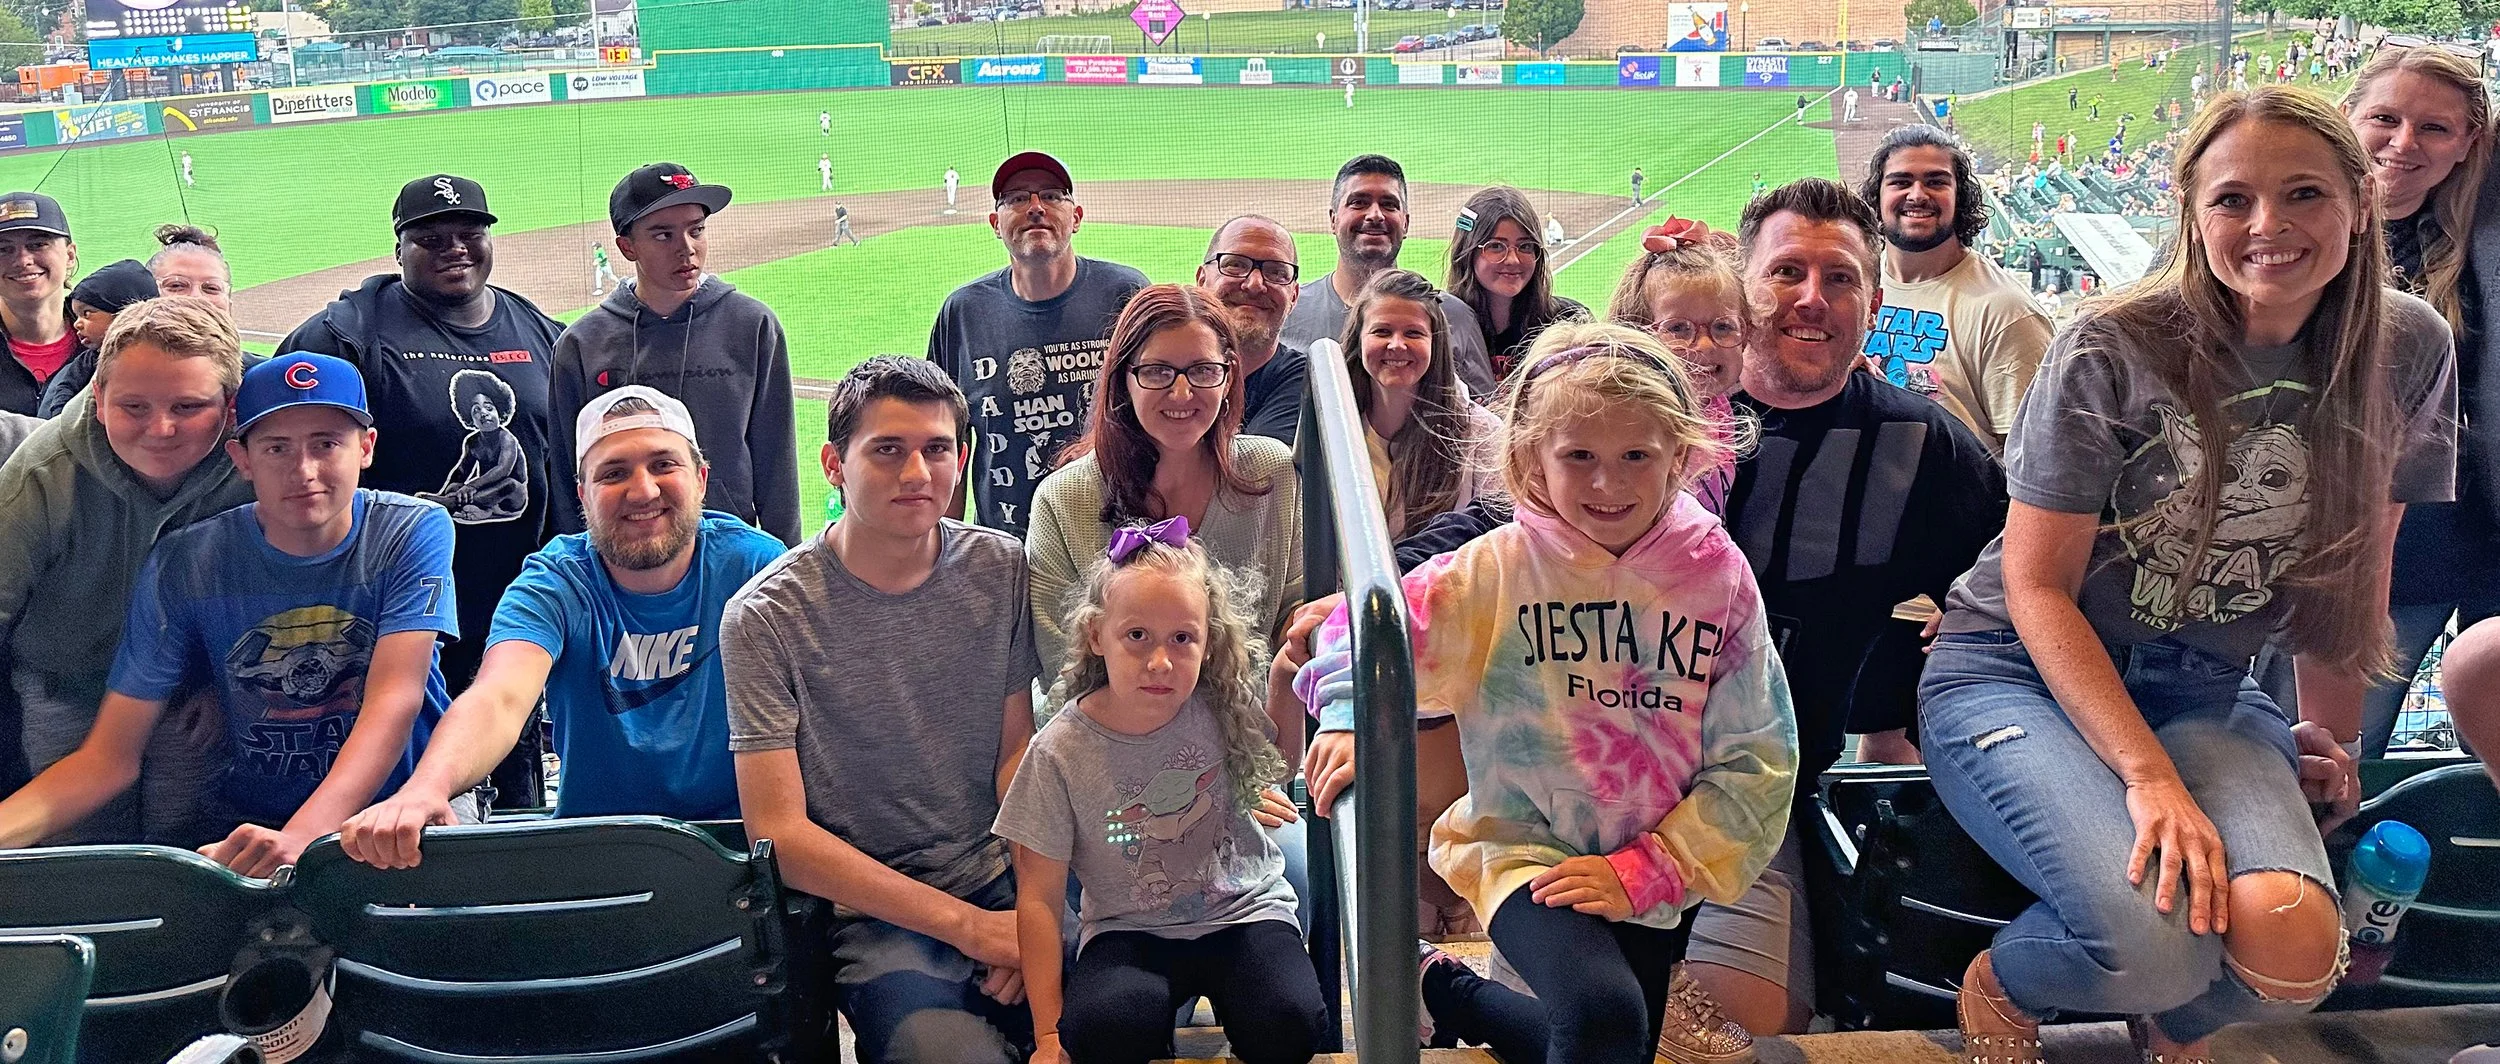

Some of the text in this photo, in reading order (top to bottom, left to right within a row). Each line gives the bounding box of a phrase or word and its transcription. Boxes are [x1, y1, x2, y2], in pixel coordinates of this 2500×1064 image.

[161, 53, 200, 65] MAKES
[201, 51, 250, 62] HAPPIER.
[977, 61, 1042, 77] Aaron's
[1746, 56, 1788, 66] DYNASTY
[907, 64, 945, 80] CFX
[387, 84, 437, 103] Modelo
[499, 81, 545, 98] pace
[272, 93, 353, 115] Pipefitters
[61, 115, 114, 143] JOLIET
[433, 177, 461, 205] Sox
[1876, 304, 1949, 341] TAR
[402, 351, 424, 360] the
[430, 352, 490, 363] notorious
[1043, 338, 1111, 354] YOU'RE AS STRONG
[1864, 330, 1949, 364] ARS
[1045, 350, 1104, 372] WOOK
[285, 361, 319, 390] C
[1058, 372, 1069, 384] AS
[1013, 394, 1066, 418] HAN
[1013, 410, 1074, 433] SOLO
[420, 576, 444, 617] 7
[2129, 606, 2168, 631] THIS
[1518, 600, 1640, 667] SIESTA
[610, 624, 700, 681] NIKE
[1567, 673, 1684, 713] Florida
[240, 715, 359, 751] STA
[245, 750, 335, 780] WA
